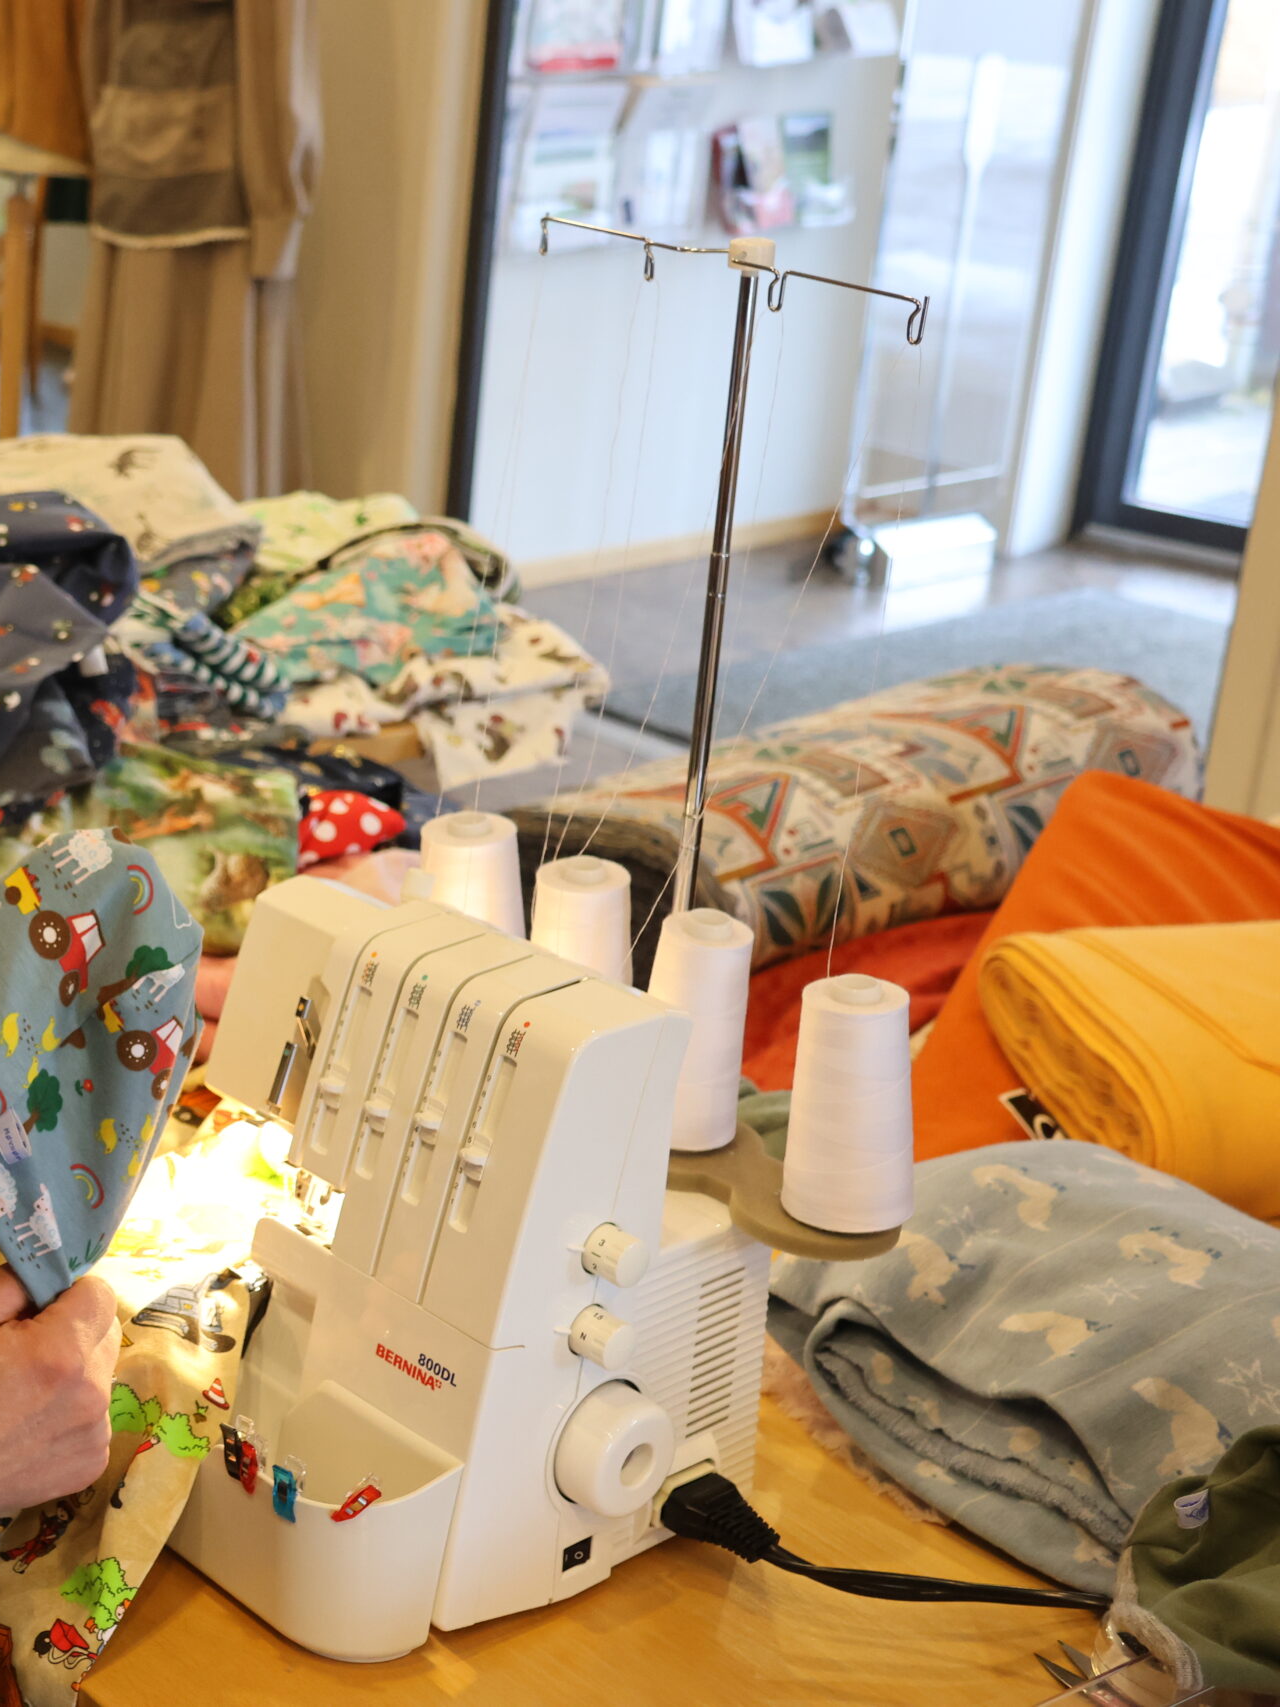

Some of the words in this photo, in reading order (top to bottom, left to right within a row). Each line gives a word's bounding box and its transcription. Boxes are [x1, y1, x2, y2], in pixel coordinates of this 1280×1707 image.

[598, 1239, 606, 1247] 3
[580, 1331, 588, 1341] N
[375, 1343, 436, 1391] BERNINA
[418, 1353, 457, 1387] 800DL
